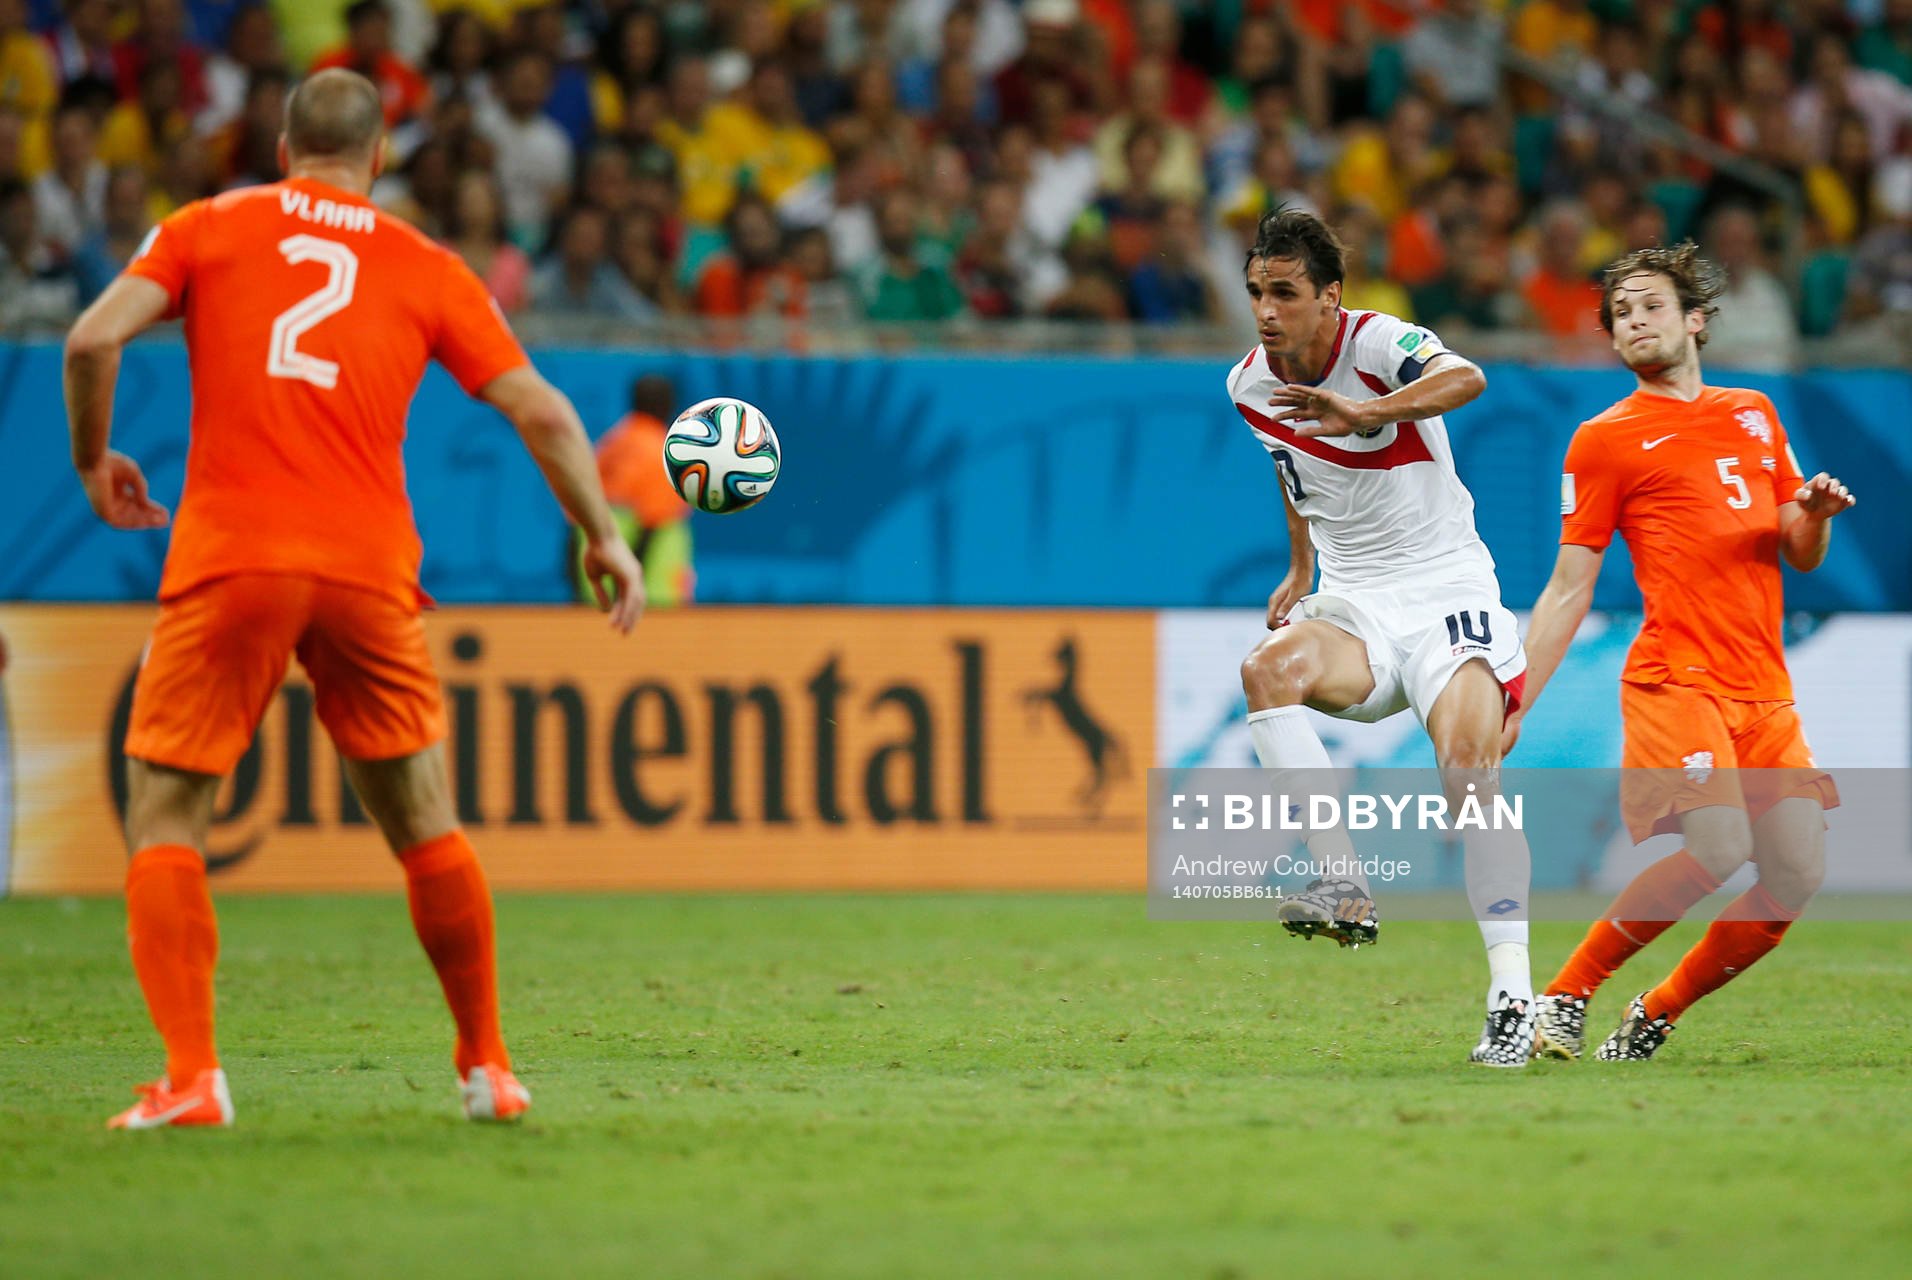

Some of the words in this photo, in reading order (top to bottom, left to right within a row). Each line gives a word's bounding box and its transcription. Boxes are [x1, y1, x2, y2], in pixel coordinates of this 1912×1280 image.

[279, 188, 376, 234] VLAAR
[267, 232, 359, 390] 2
[1714, 456, 1752, 510] 5
[107, 630, 993, 876] Cninental
